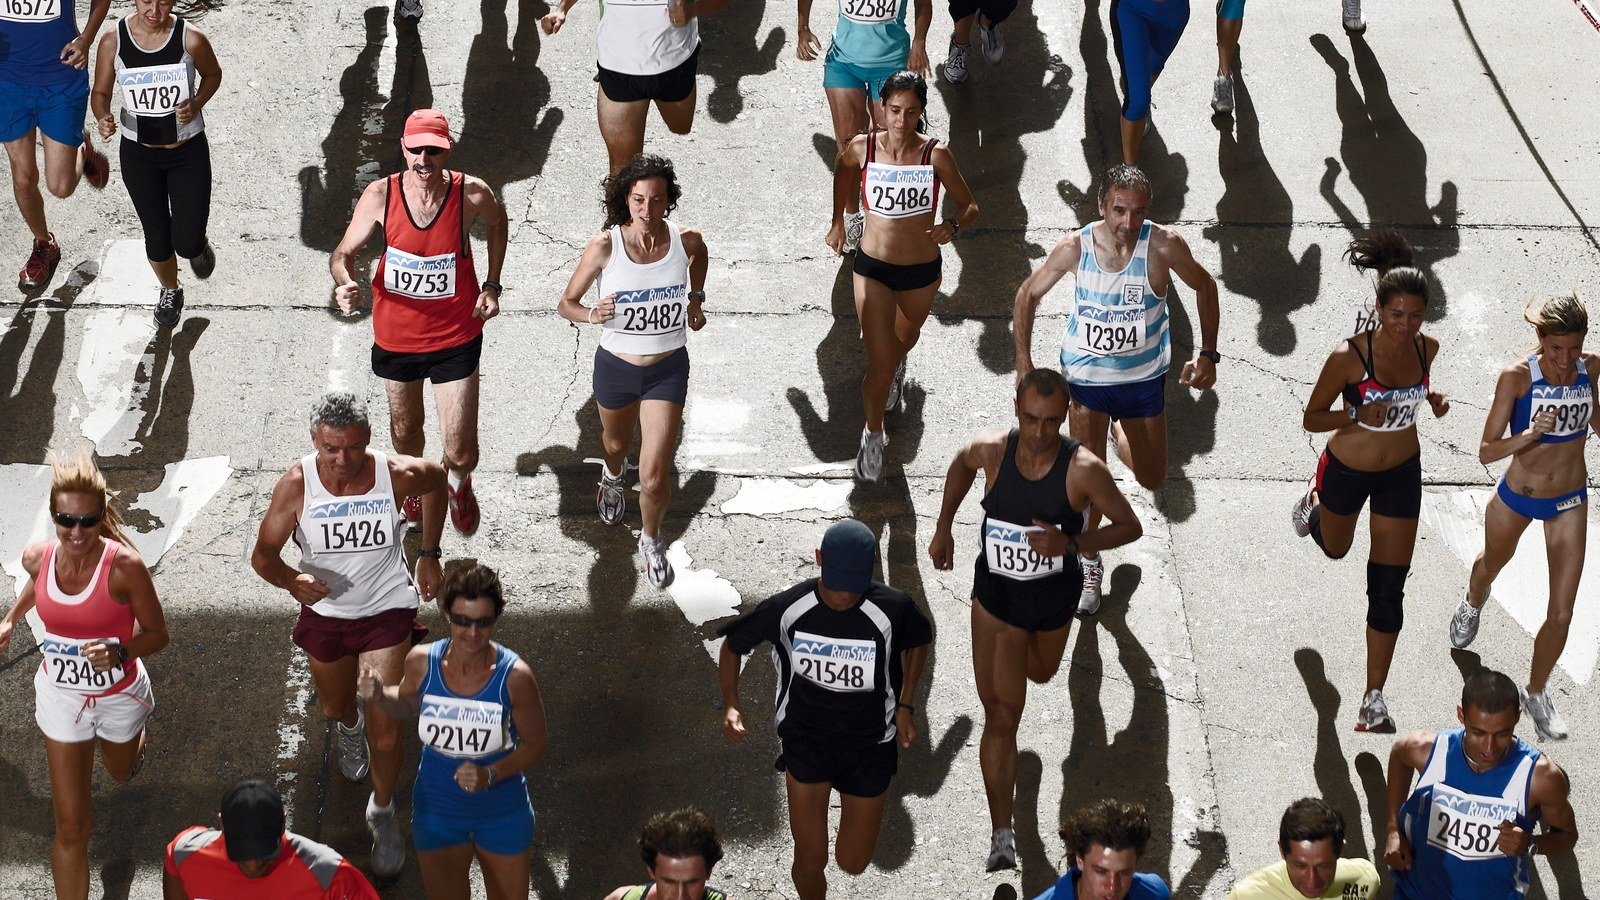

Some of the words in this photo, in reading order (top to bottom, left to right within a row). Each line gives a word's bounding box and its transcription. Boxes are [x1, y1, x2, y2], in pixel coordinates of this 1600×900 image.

[845, 0, 896, 17] 32584
[152, 68, 187, 83] RunStyle
[129, 85, 180, 109] 14782
[896, 169, 934, 183] RunStyle
[873, 186, 930, 211] 25486
[417, 256, 456, 271] RunStyle
[393, 269, 448, 293] 19753
[648, 284, 685, 302] RunStyle
[623, 302, 682, 331] 23482
[1107, 308, 1145, 323] RunStyle
[1085, 323, 1138, 351] 12394
[1392, 384, 1428, 402] RunStyle
[1387, 402, 1419, 428] 924
[347, 499, 391, 516] RunStyle
[321, 520, 386, 549] 15426
[994, 543, 1054, 573] 13594
[831, 644, 875, 661] RunStyle
[800, 657, 864, 688] 21548
[457, 706, 501, 724] RunStyle
[427, 723, 491, 752] 22147
[1467, 801, 1517, 821] RunStyle
[1436, 811, 1500, 853] 24587
